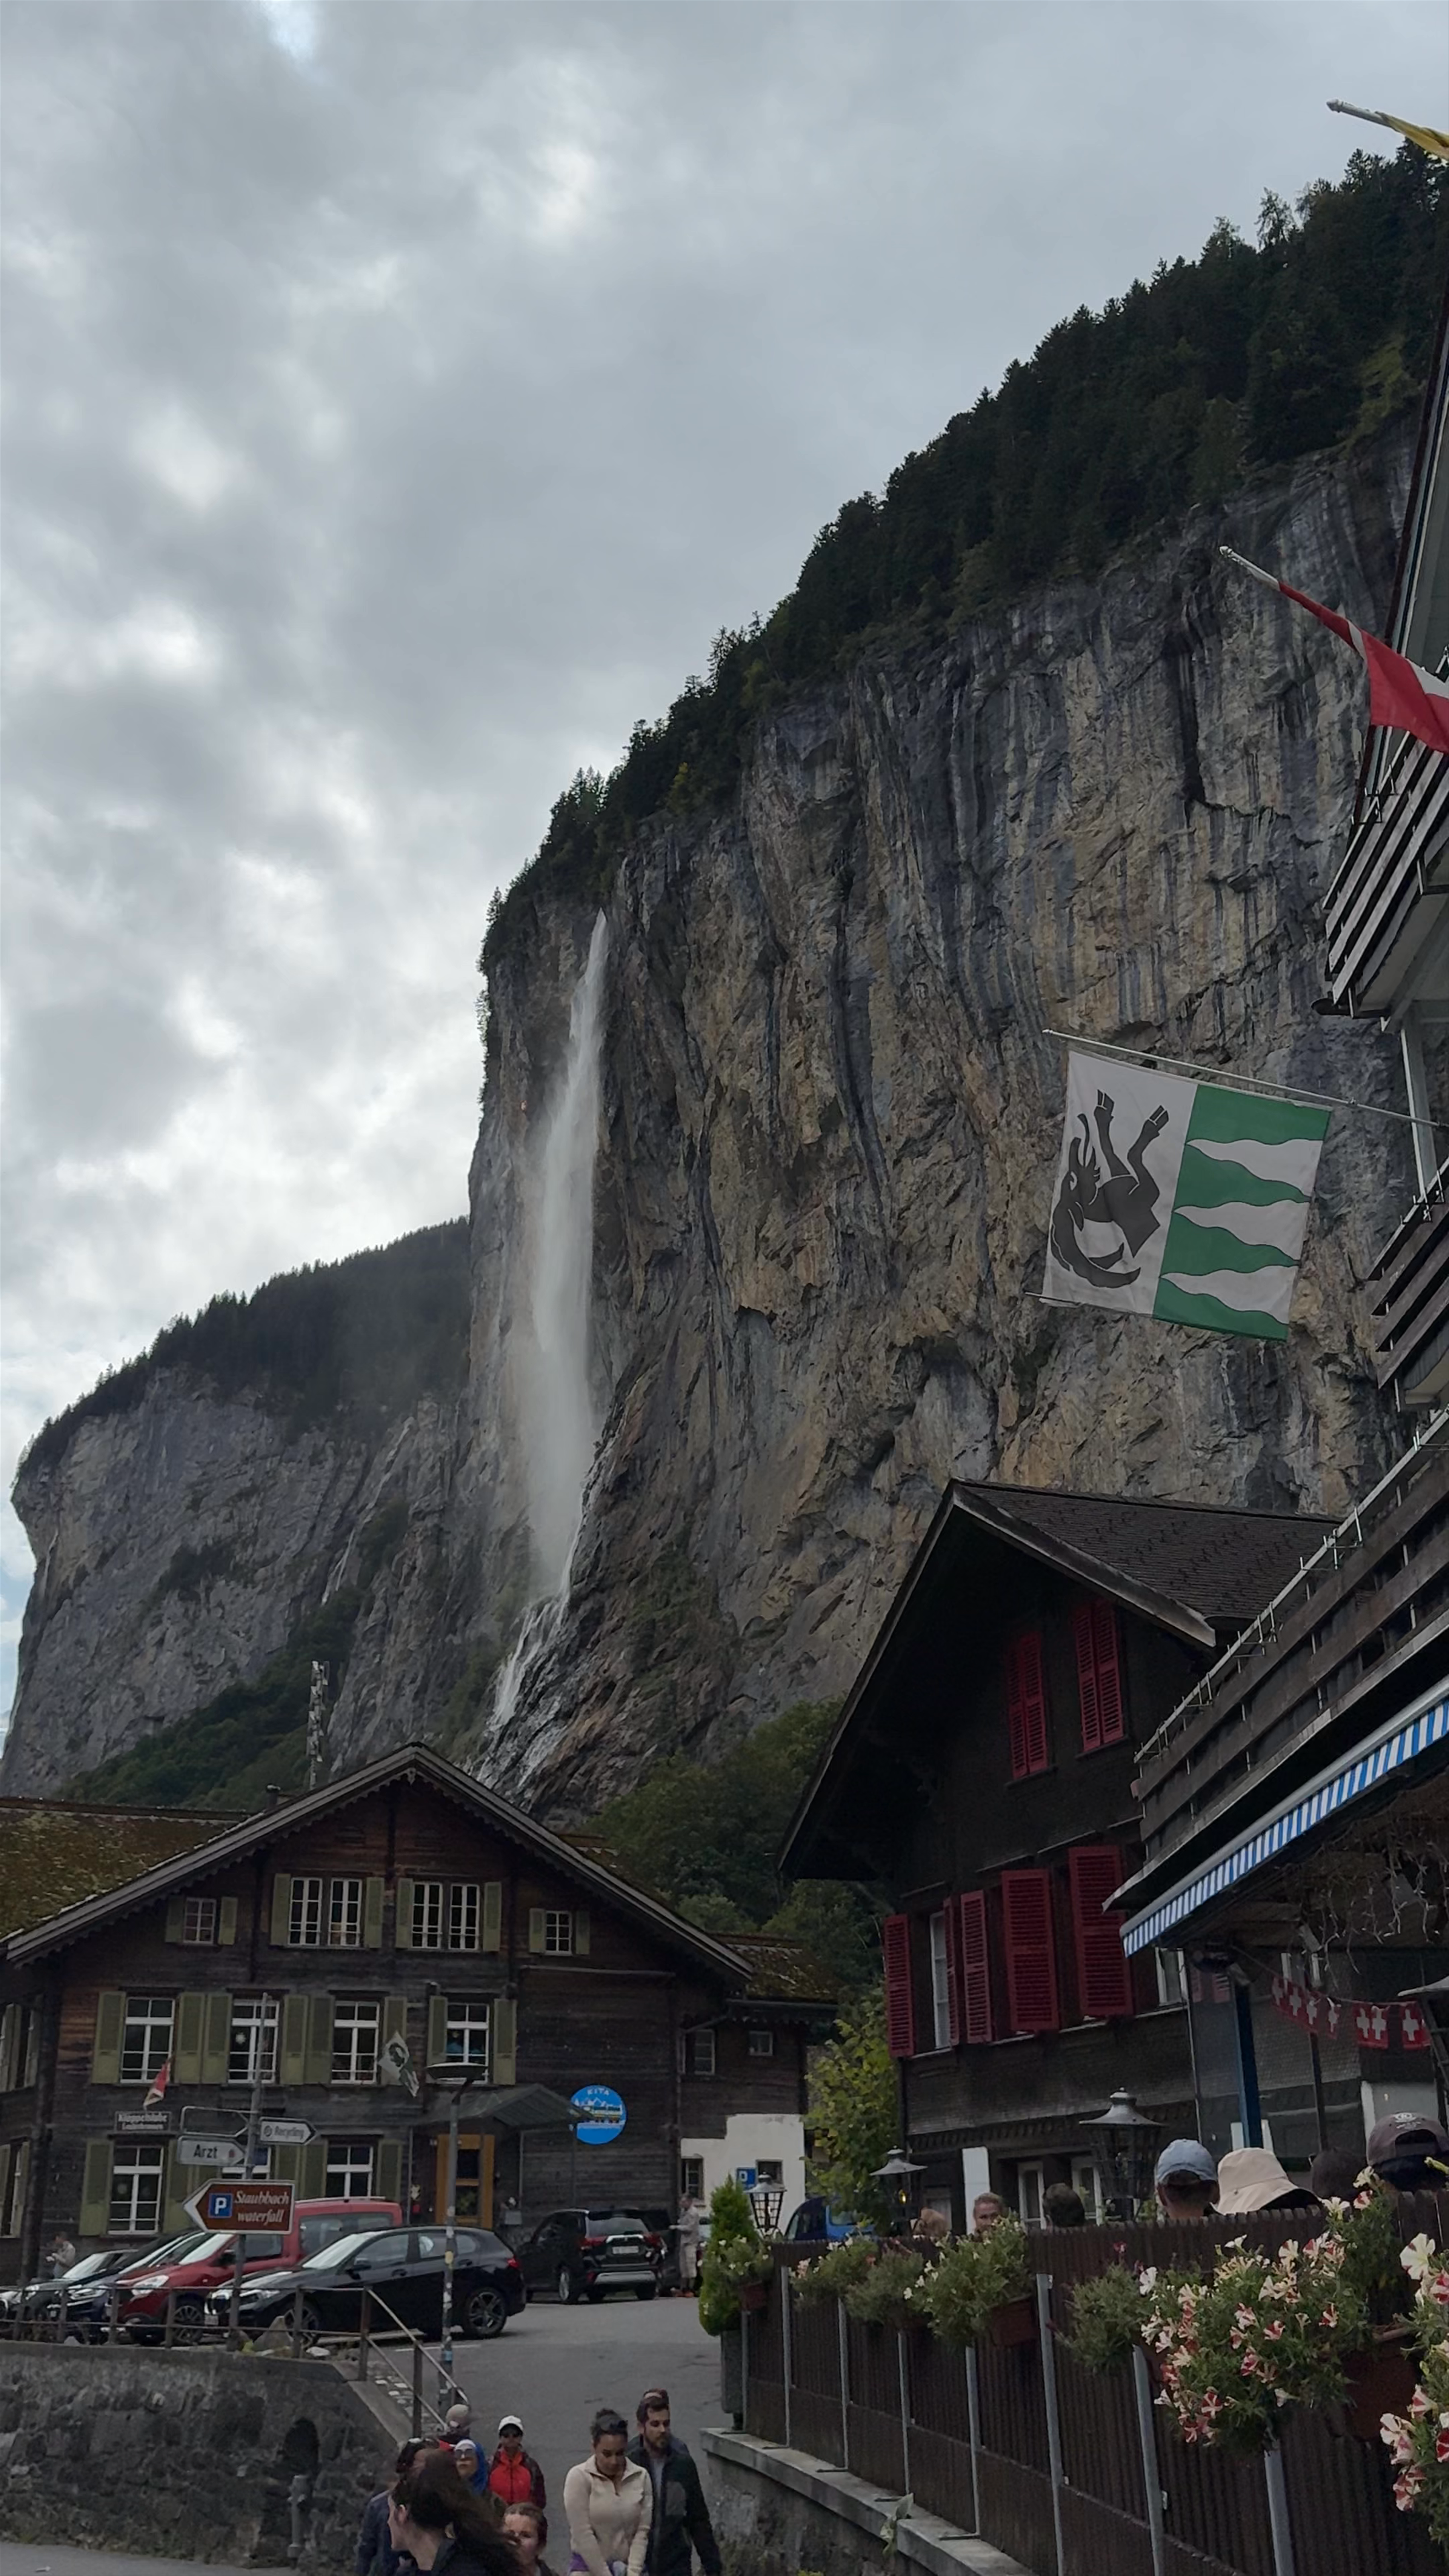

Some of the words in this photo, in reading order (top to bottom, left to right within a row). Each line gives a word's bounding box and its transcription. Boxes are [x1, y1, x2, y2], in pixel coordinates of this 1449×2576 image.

[193, 2144, 218, 2158] Arzt
[235, 2190, 289, 2205] Staubbach
[215, 2197, 227, 2215] P
[238, 2209, 284, 2224] waterfall
